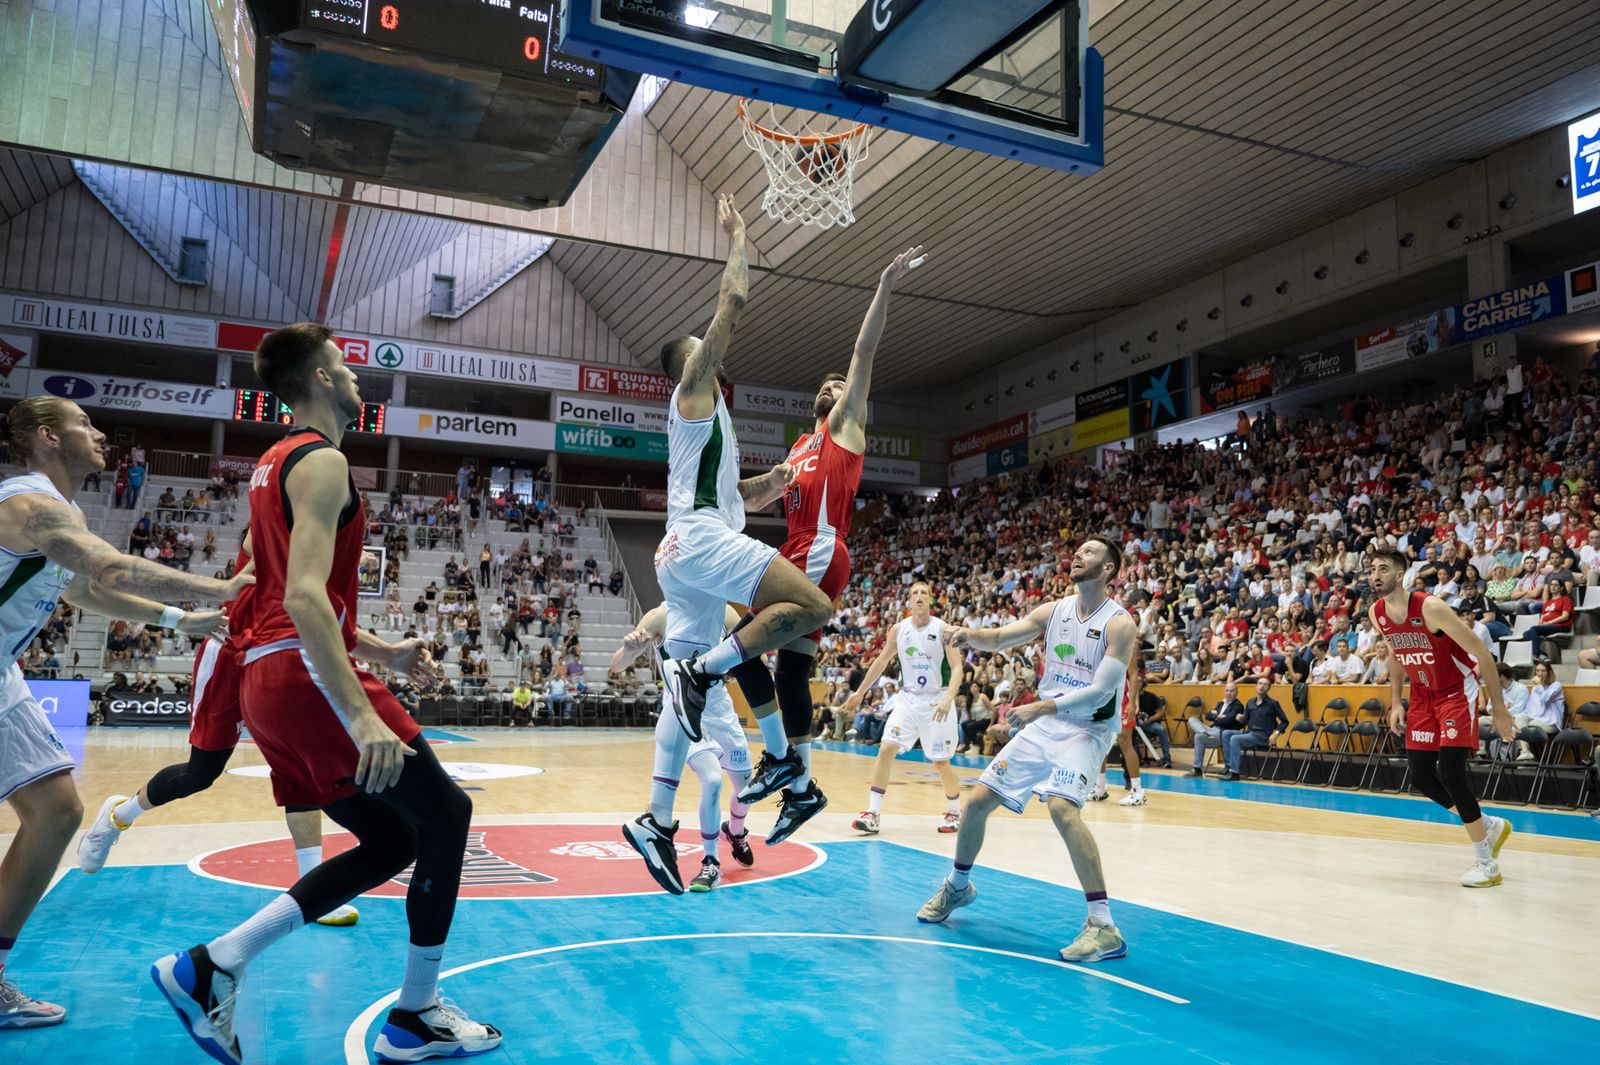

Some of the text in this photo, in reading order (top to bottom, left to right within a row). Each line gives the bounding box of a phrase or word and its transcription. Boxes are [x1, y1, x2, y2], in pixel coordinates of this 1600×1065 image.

[380, 5, 399, 30] 0
[519, 6, 549, 23] Falta
[523, 36, 541, 60] 0
[1462, 280, 1550, 318] CALSINA
[45, 305, 98, 332] LLEAL
[442, 354, 484, 377] LLEAL
[100, 396, 142, 409] group
[102, 379, 214, 405] infoself
[561, 400, 635, 425] Panella
[436, 414, 517, 437] parlem
[219, 459, 249, 470] girona
[917, 676, 927, 688] 9
